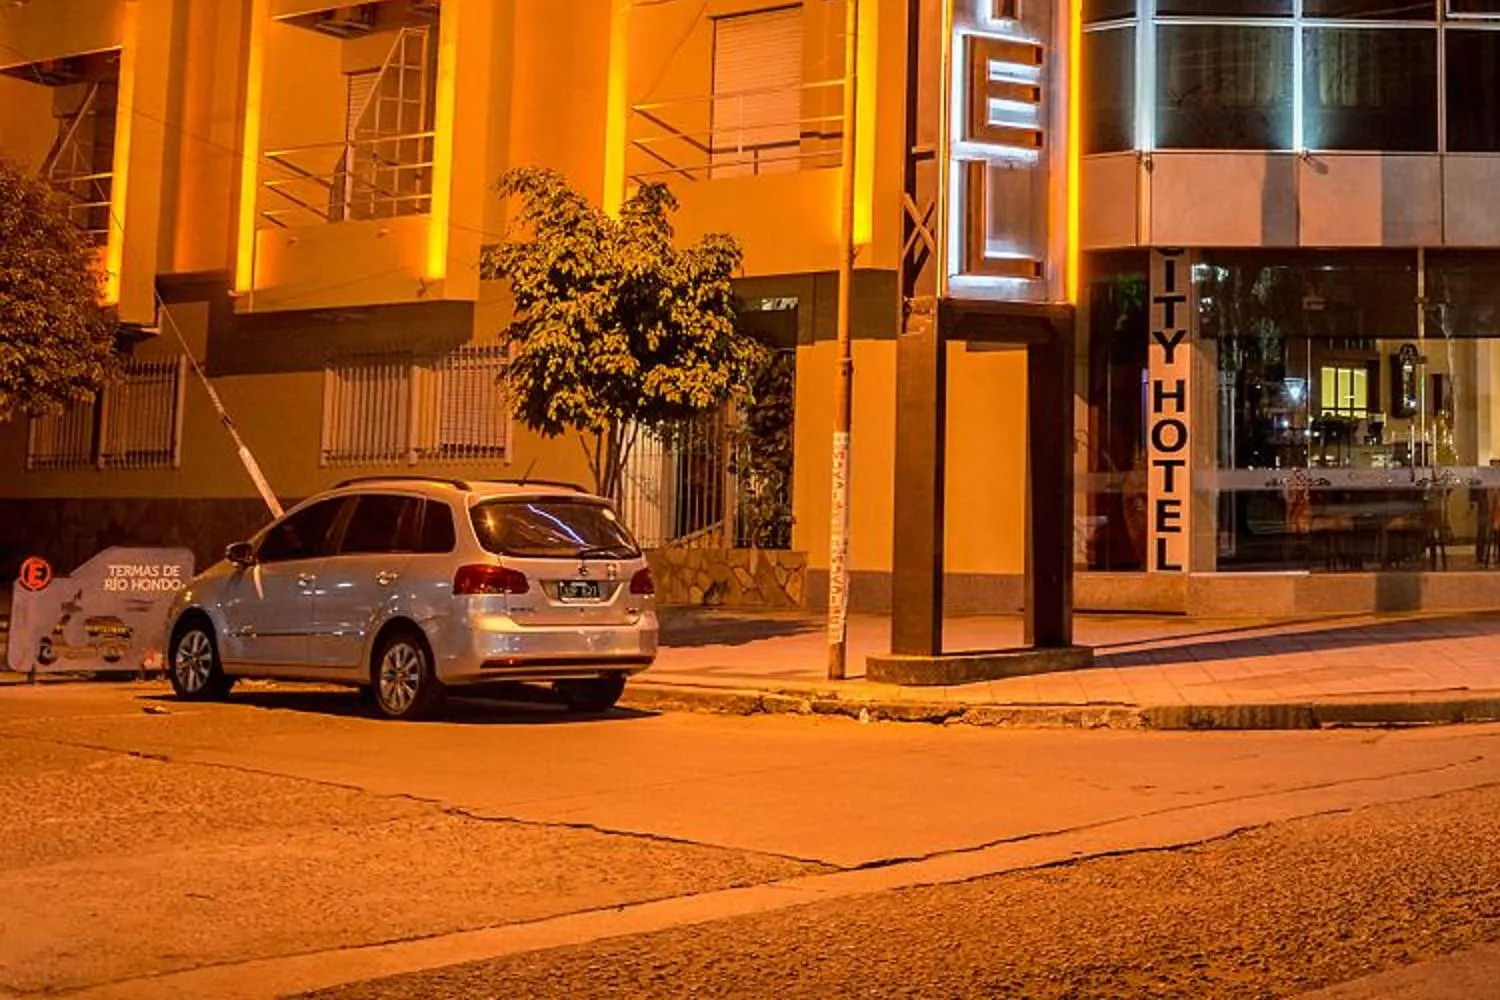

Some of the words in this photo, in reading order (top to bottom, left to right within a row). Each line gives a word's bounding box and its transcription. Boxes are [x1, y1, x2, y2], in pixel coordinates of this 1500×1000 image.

[1151, 379, 1188, 572] HOTEL
[108, 564, 159, 577] TERMAS
[163, 564, 181, 577] DE
[131, 578, 182, 592] HONDO
